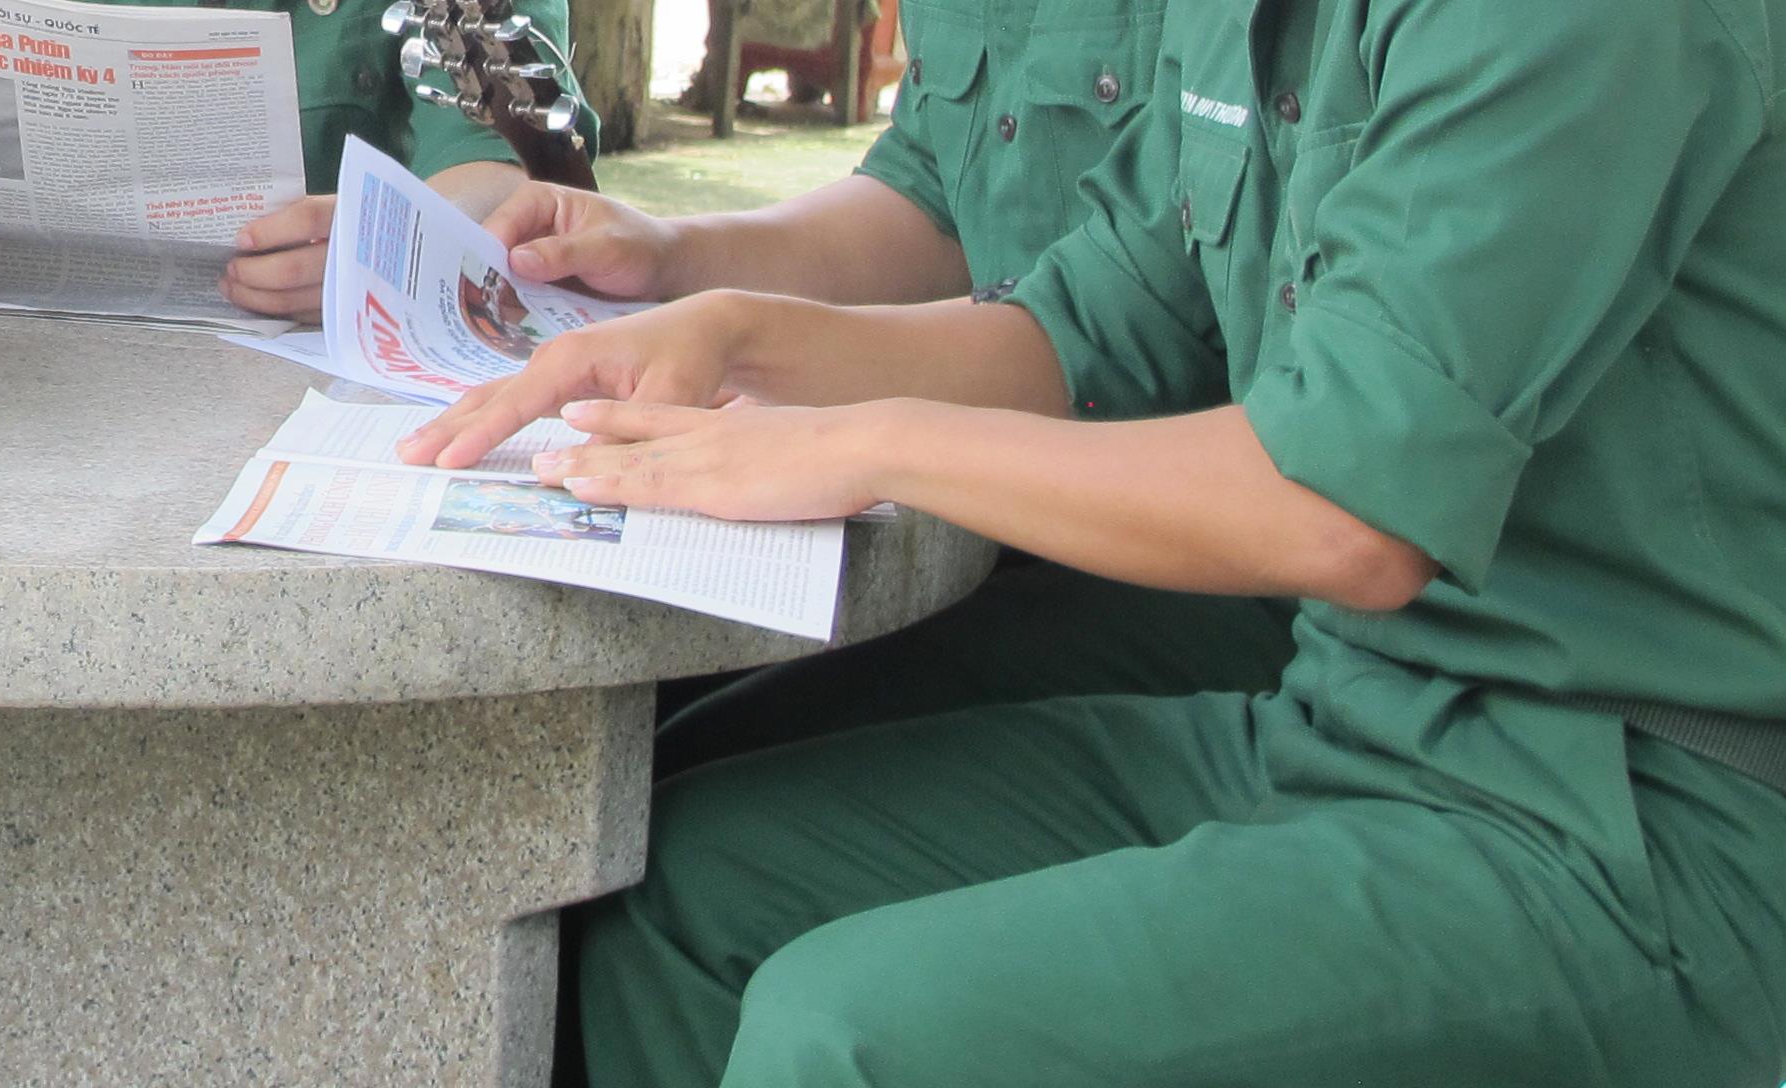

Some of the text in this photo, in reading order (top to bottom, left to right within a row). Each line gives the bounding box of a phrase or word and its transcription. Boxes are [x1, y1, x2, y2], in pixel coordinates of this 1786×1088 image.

[44, 16, 83, 33] QUỐC
[18, 34, 70, 59] Putin
[13, 57, 72, 81] nhiệm
[76, 64, 98, 85] kỳ
[103, 68, 116, 85] 4
